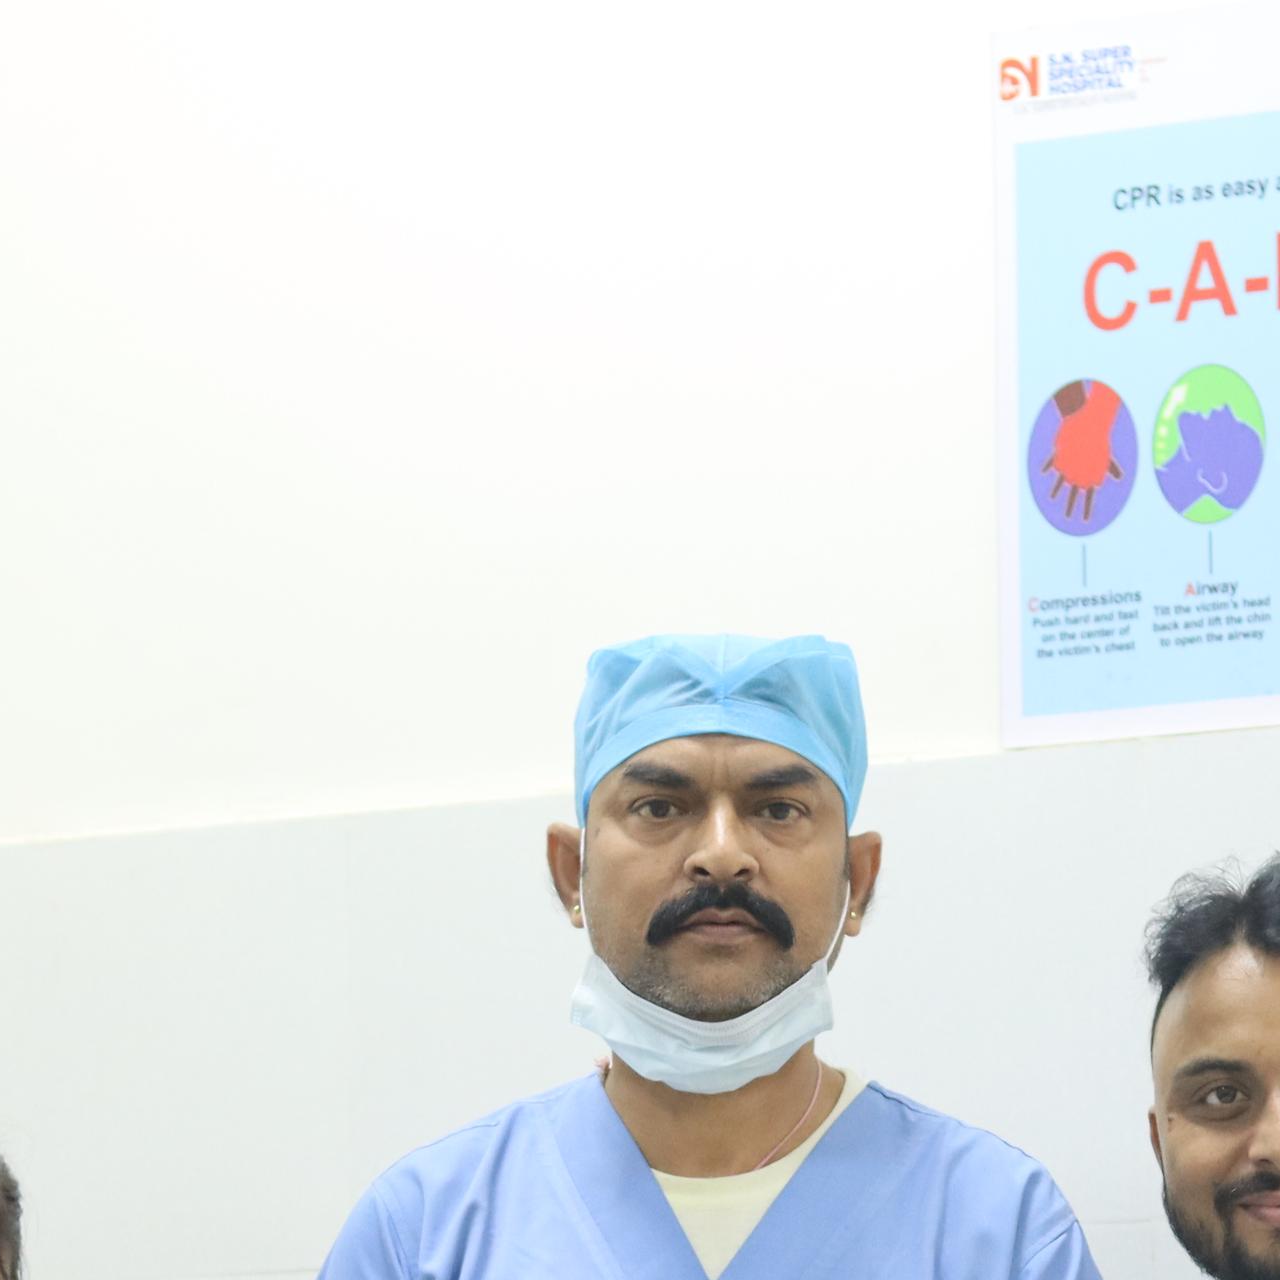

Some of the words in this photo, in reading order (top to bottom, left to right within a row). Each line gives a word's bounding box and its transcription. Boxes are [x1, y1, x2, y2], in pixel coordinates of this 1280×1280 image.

[1049, 76, 1124, 95] HOSPITAL
[1113, 185, 1162, 211] CPR
[1170, 184, 1185, 203] is
[1192, 184, 1215, 202] as
[1221, 177, 1269, 199] easy
[1185, 581, 1239, 596] Airway
[1028, 589, 1142, 613] Compressions
[1174, 604, 1191, 615] the
[1195, 598, 1239, 613] victim's
[1243, 595, 1272, 608] head
[1094, 611, 1114, 623] and
[1152, 621, 1179, 633] back
[1183, 618, 1204, 630] and
[1225, 615, 1243, 626] the
[1247, 611, 1272, 624] chin
[1160, 637, 1171, 648] to
[1175, 634, 1202, 648] open
[1206, 631, 1223, 643] the
[1227, 629, 1265, 643] airway
